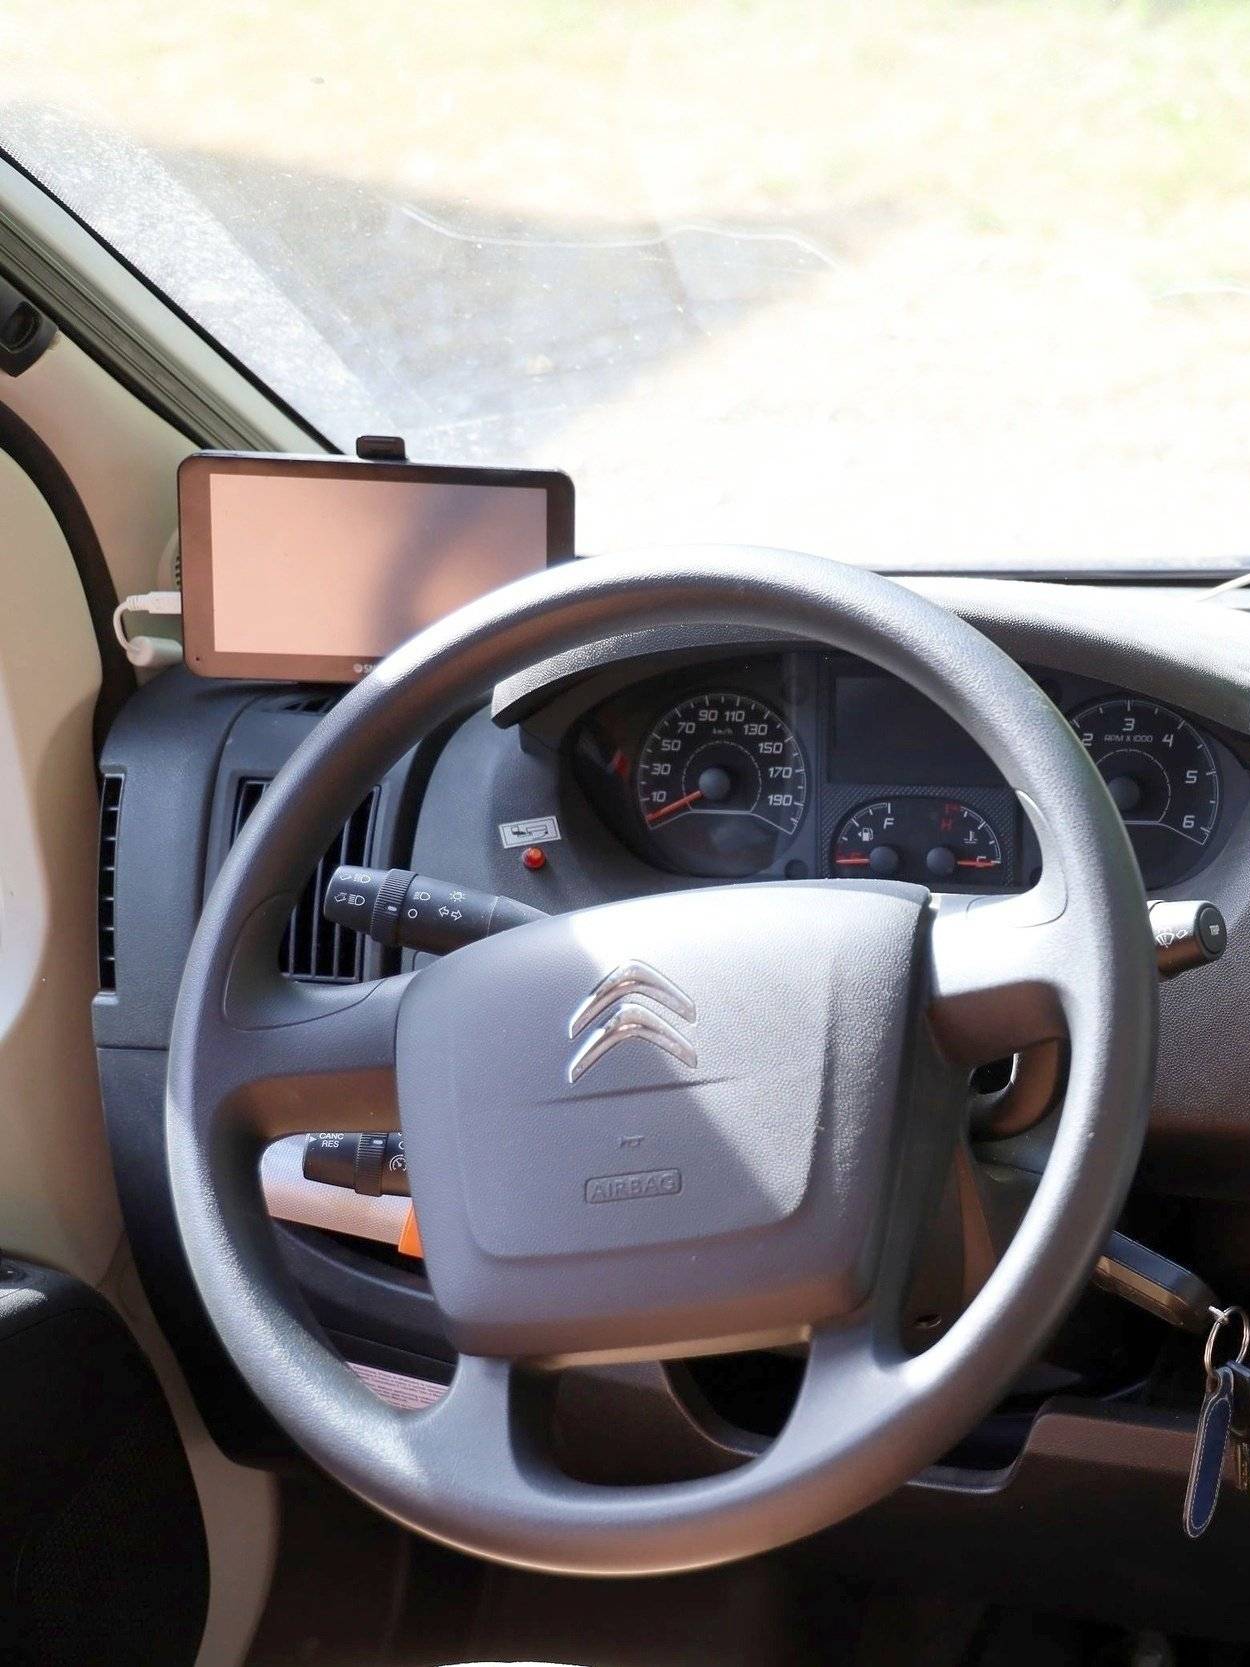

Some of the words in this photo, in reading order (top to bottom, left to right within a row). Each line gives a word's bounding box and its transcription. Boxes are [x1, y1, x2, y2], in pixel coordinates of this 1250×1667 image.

[699, 710, 718, 722] 90
[724, 710, 745, 722] 110
[678, 722, 696, 734] 70
[743, 723, 768, 736] 130
[1122, 717, 1136, 732] 3
[1081, 733, 1094, 747] 2
[1104, 734, 1125, 742] RPM
[1162, 734, 1175, 748] 4
[661, 740, 681, 751] 50
[758, 741, 783, 754] 150
[651, 763, 671, 776] 30
[768, 767, 793, 779] 170
[1184, 770, 1199, 784] 5
[651, 790, 667, 803] 10
[767, 794, 793, 807] 190
[883, 817, 895, 830] F
[1182, 815, 1196, 829] 6
[319, 1132, 345, 1140] CANC
[321, 1140, 339, 1148] RES
[590, 1173, 677, 1201] AIRBAG
